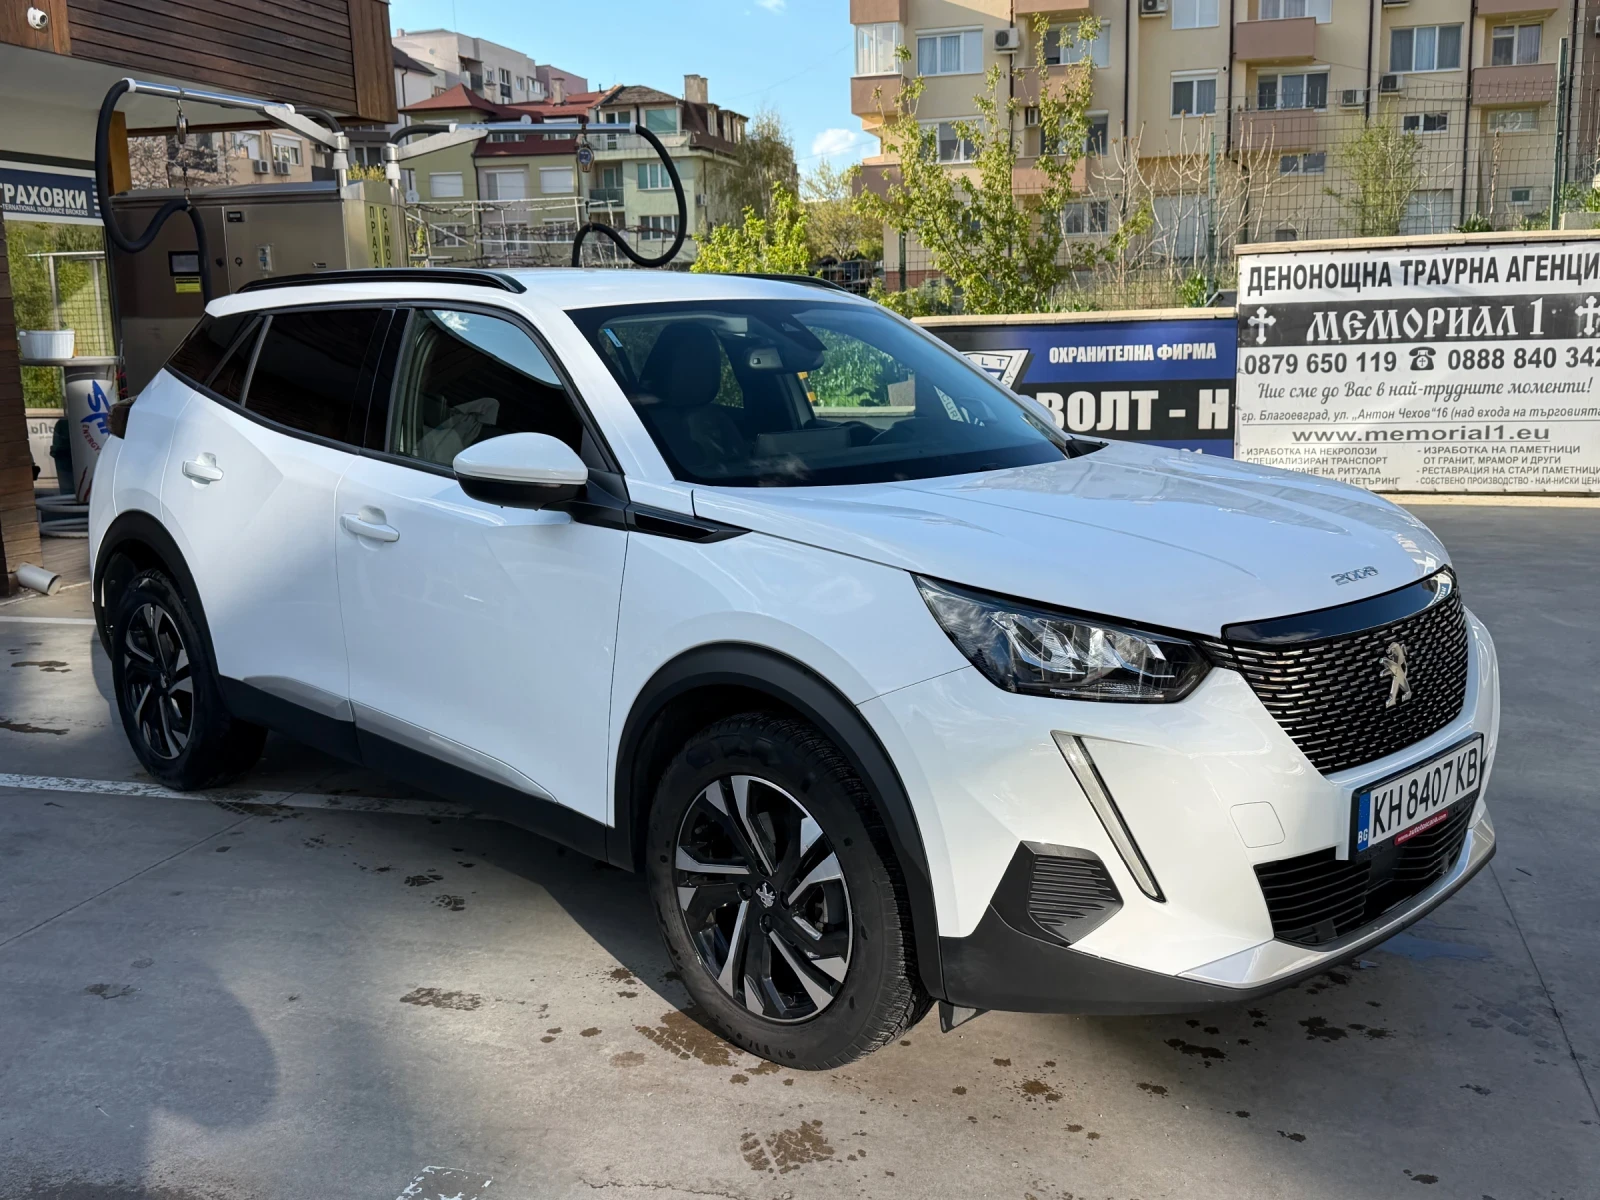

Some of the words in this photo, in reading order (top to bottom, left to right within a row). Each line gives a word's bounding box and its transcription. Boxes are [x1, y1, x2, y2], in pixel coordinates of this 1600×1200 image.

[0, 182, 88, 210] РАХОВКИ
[0, 203, 36, 212] TERNATIONAL
[37, 207, 65, 215] INSURANCE
[369, 206, 379, 268] ПРАХ
[1247, 261, 1392, 296] ДЕНОНОЩНА
[1400, 256, 1499, 286] ТРАУРНА
[1505, 252, 1600, 286] АГЕНЦИ
[1306, 305, 1518, 342] МЕМОРИАЛ
[1530, 297, 1544, 335] 1
[1049, 344, 1154, 364] ОХРАНИТЕЛНА
[1157, 342, 1217, 361] ФИРМА
[1244, 353, 1299, 375] 0879
[1306, 352, 1347, 373] 650
[1356, 350, 1397, 373] 119
[1448, 348, 1505, 370] 0888
[1513, 346, 1557, 369] 840
[1258, 382, 1285, 399] Ние
[1289, 387, 1317, 399] сме
[1320, 387, 1339, 405] до
[1344, 380, 1373, 398] Вас
[1376, 381, 1385, 397] в
[1388, 380, 1504, 403] най-трудните
[1507, 376, 1594, 395] моменти!
[1036, 390, 1159, 432] ВОЛТ
[1198, 388, 1230, 430] Н
[1241, 412, 1257, 423] гр.
[1259, 408, 1331, 423] Благоевград,
[1333, 412, 1349, 423] ул.
[1450, 406, 1475, 421] (над
[1477, 405, 1510, 419] входа
[1513, 408, 1526, 418] на
[1529, 406, 1600, 419] търговият
[82, 424, 102, 453] ENERGY
[1292, 425, 1550, 442] www.memorial1.eu
[1246, 447, 1301, 456] ИЗРАБОТКА
[1304, 447, 1317, 456] НА
[1320, 447, 1377, 456] НЕКРОЛОЗИ
[1424, 446, 1488, 454] ИЗРАБОТКА
[1491, 446, 1506, 454] НА
[1510, 445, 1581, 454] ПАМЕТНИЦИ
[1331, 456, 1388, 465] ТРАНСПОРТ
[1423, 457, 1436, 465] ОТ
[1438, 456, 1476, 466] ГРАНИТ,
[1478, 456, 1519, 465] МРАМОР
[1521, 456, 1528, 464] И
[1530, 456, 1561, 465] ДРУГИ
[1322, 467, 1335, 475] НА
[1337, 466, 1381, 475] РИТУАЛА
[1422, 466, 1490, 475] РЕСТАВРАЦИЯ
[1492, 466, 1506, 475] НА
[1508, 466, 1539, 474] СТАРИ
[1350, 477, 1400, 485] КЕТЪРИНГ
[1420, 476, 1466, 485] СОБСТВЕНО
[1467, 476, 1529, 486] ПРОИЗВОДСТВО
[1535, 475, 1580, 485] НАЙ-НИСКИ
[1330, 565, 1379, 586] 2008
[1407, 759, 1454, 820] 8407
[1358, 828, 1369, 845] BG
